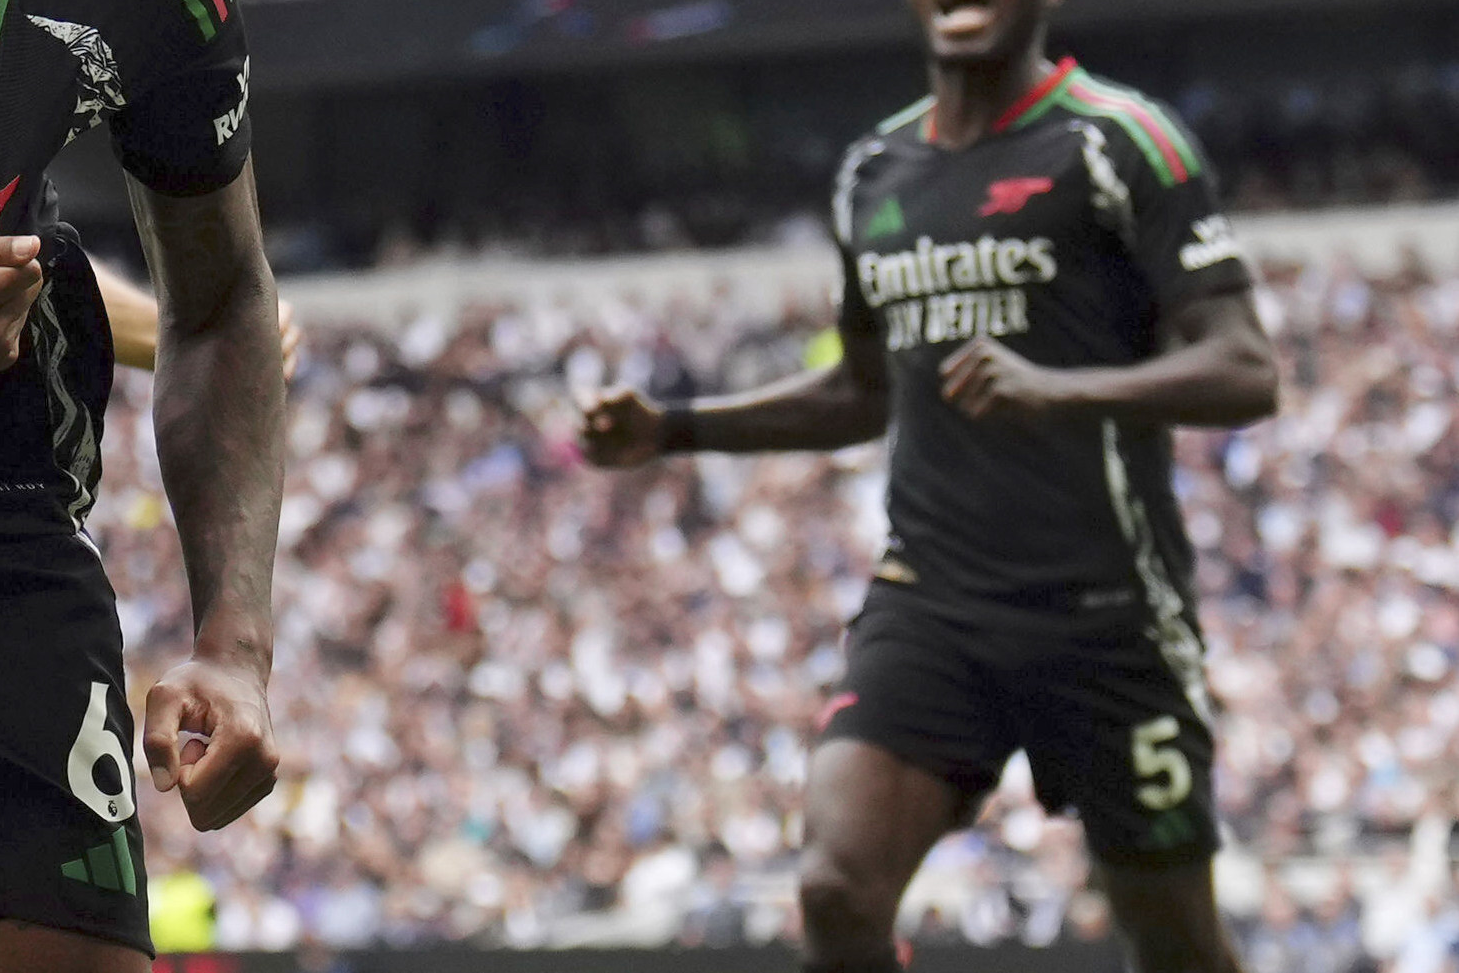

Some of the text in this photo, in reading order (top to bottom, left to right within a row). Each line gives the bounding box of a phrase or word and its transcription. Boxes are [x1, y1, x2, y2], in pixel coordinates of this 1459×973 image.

[857, 234, 1058, 308] Emirates
[67, 681, 136, 822] 6
[1131, 714, 1192, 811] 5
